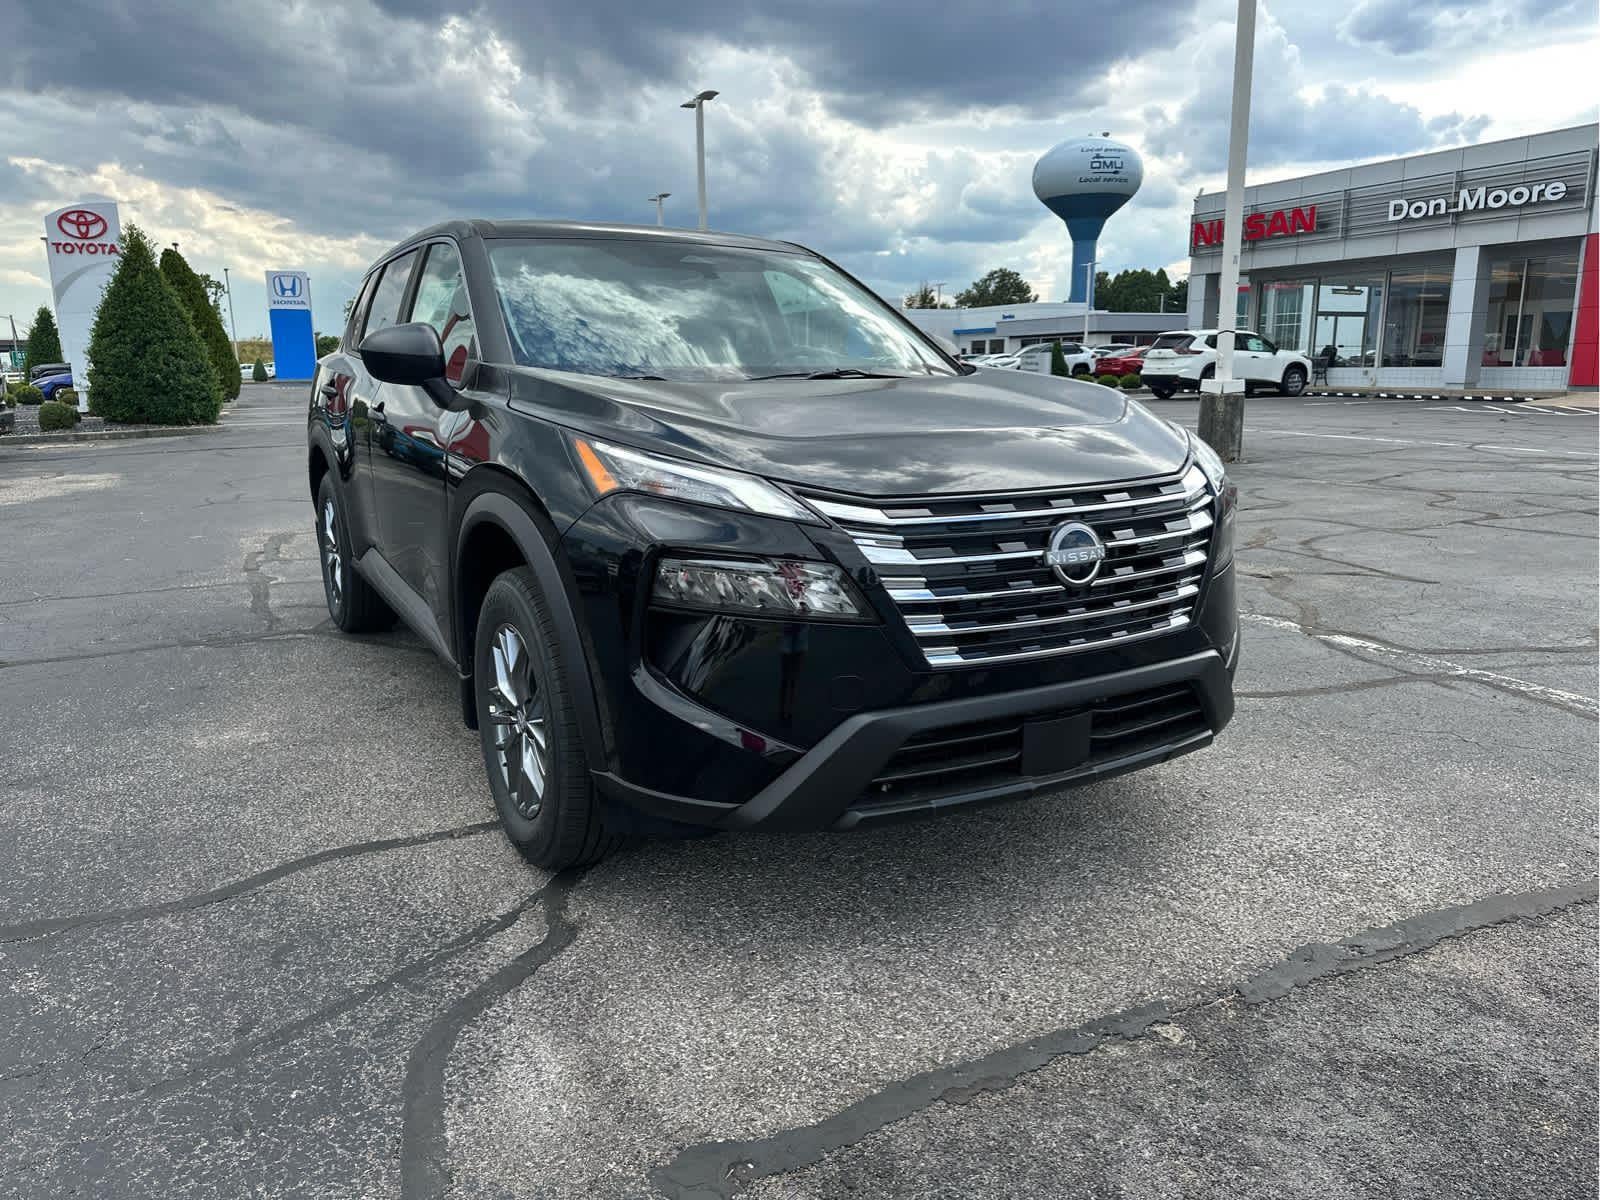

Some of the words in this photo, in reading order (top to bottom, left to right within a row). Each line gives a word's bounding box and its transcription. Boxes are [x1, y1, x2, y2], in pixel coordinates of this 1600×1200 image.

[1090, 160, 1123, 169] OMU
[1388, 198, 1446, 221] Don
[1456, 181, 1567, 212] Moore
[1193, 204, 1317, 248] NISAN
[51, 242, 119, 255] TOYOTA
[1048, 547, 1105, 565] NISSAN
